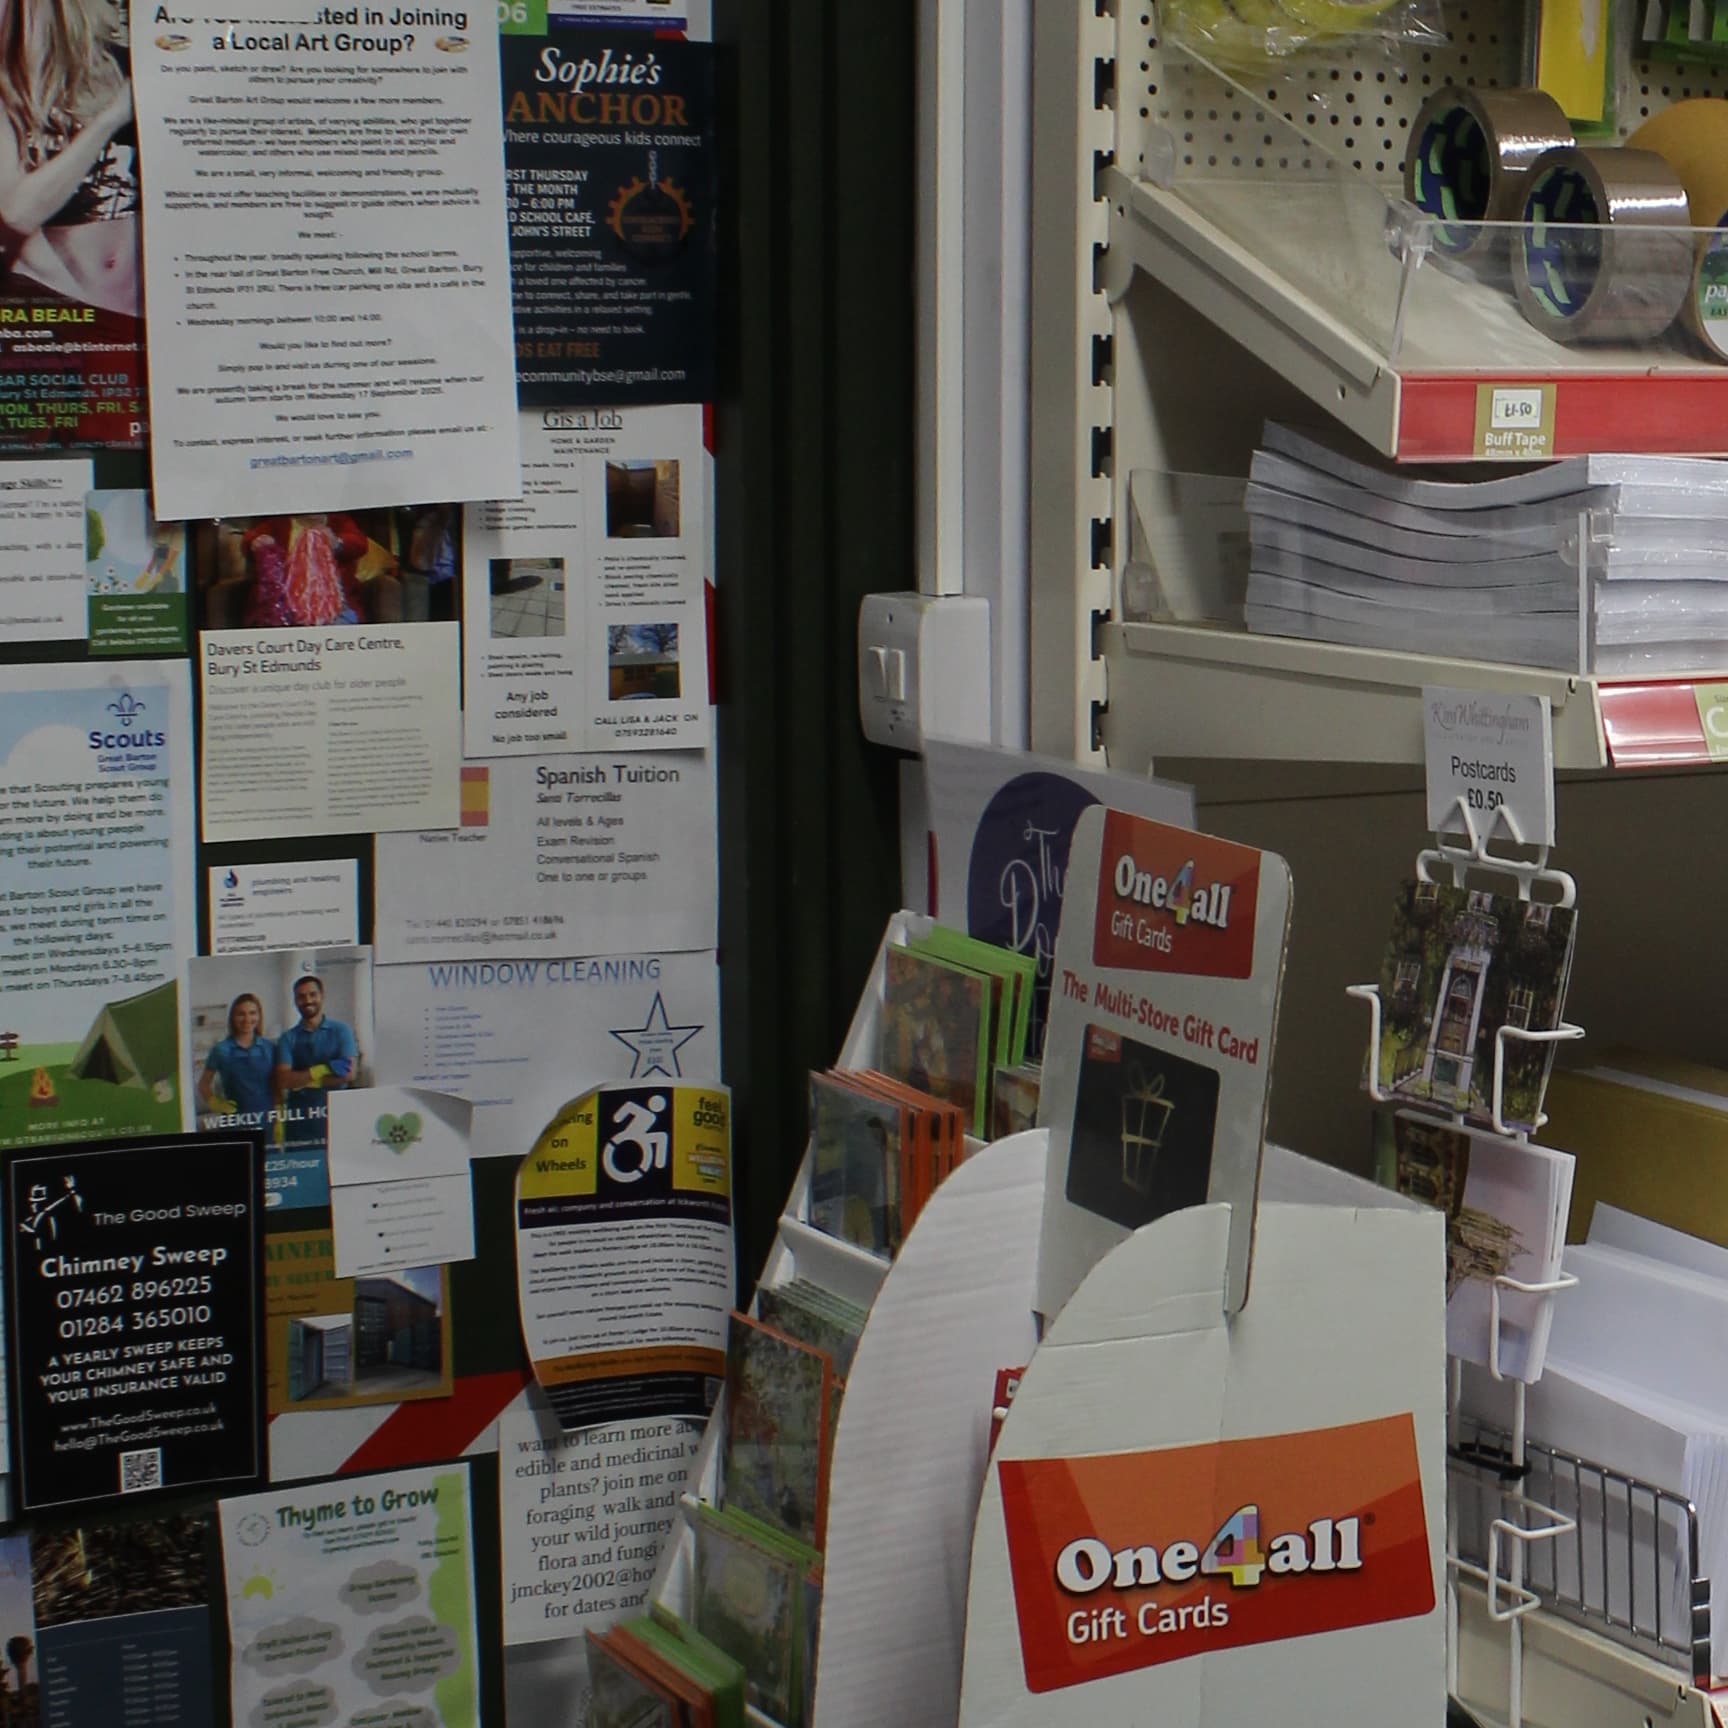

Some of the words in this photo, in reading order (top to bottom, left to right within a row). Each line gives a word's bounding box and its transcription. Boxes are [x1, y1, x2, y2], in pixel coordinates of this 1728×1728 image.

[364, 7, 384, 27] in
[389, 6, 468, 31] Joining
[232, 31, 289, 53] Local
[295, 31, 328, 52] Art
[332, 30, 416, 59] Group?
[535, 46, 662, 94] Sophie's
[505, 90, 689, 126] ANCHOR
[543, 130, 621, 148] courageous
[625, 130, 652, 145] kids
[31, 307, 95, 325] BEALE
[1484, 431, 1515, 448] Buff
[1516, 432, 1547, 449] Tape
[208, 638, 255, 656] Davers
[258, 637, 294, 655] Court
[296, 638, 322, 657] Day
[325, 636, 354, 654] Care
[208, 659, 239, 678] Bury
[262, 657, 322, 674] Edmunds
[89, 729, 165, 750] Scouts
[536, 765, 606, 789] Spanish
[612, 764, 680, 784] Tuition
[1451, 755, 1517, 783] Postcards
[1113, 854, 1232, 929] One4all
[1111, 910, 1133, 941] Gift
[1136, 919, 1172, 953] Cards
[429, 960, 538, 988] WINDOW
[546, 957, 662, 985] CLEANING
[1062, 969, 1088, 1002] The
[1094, 982, 1179, 1037] Multi-Store
[1183, 1014, 1214, 1049] Gift
[1217, 1026, 1259, 1065] Card
[94, 1212, 125, 1227] The
[130, 1205, 181, 1223] Good
[186, 1202, 247, 1219] Sweep
[41, 1254, 144, 1279] Chimney
[152, 1245, 228, 1267] Sweep
[57, 1284, 125, 1310] 07462
[131, 1275, 212, 1302] 896225
[60, 1315, 125, 1340] 01284
[132, 1304, 212, 1331] 365010
[123, 1341, 174, 1360] SWEEP
[178, 1335, 225, 1353] KEEPS
[606, 1441, 685, 1468] medicinal
[540, 1476, 600, 1504] plants?
[602, 1473, 635, 1497] join
[639, 1473, 664, 1488] me
[276, 1501, 347, 1529] Thyme
[351, 1496, 376, 1518] to
[380, 1485, 439, 1512] Grow
[526, 1503, 597, 1527] foraging
[603, 1496, 642, 1516] walk
[531, 1530, 571, 1553] your
[575, 1522, 611, 1544] wild
[614, 1515, 676, 1544] journey
[1055, 1502, 1364, 1595] One4all
[1066, 1604, 1128, 1645] Gift
[1137, 1596, 1230, 1636] Cards
